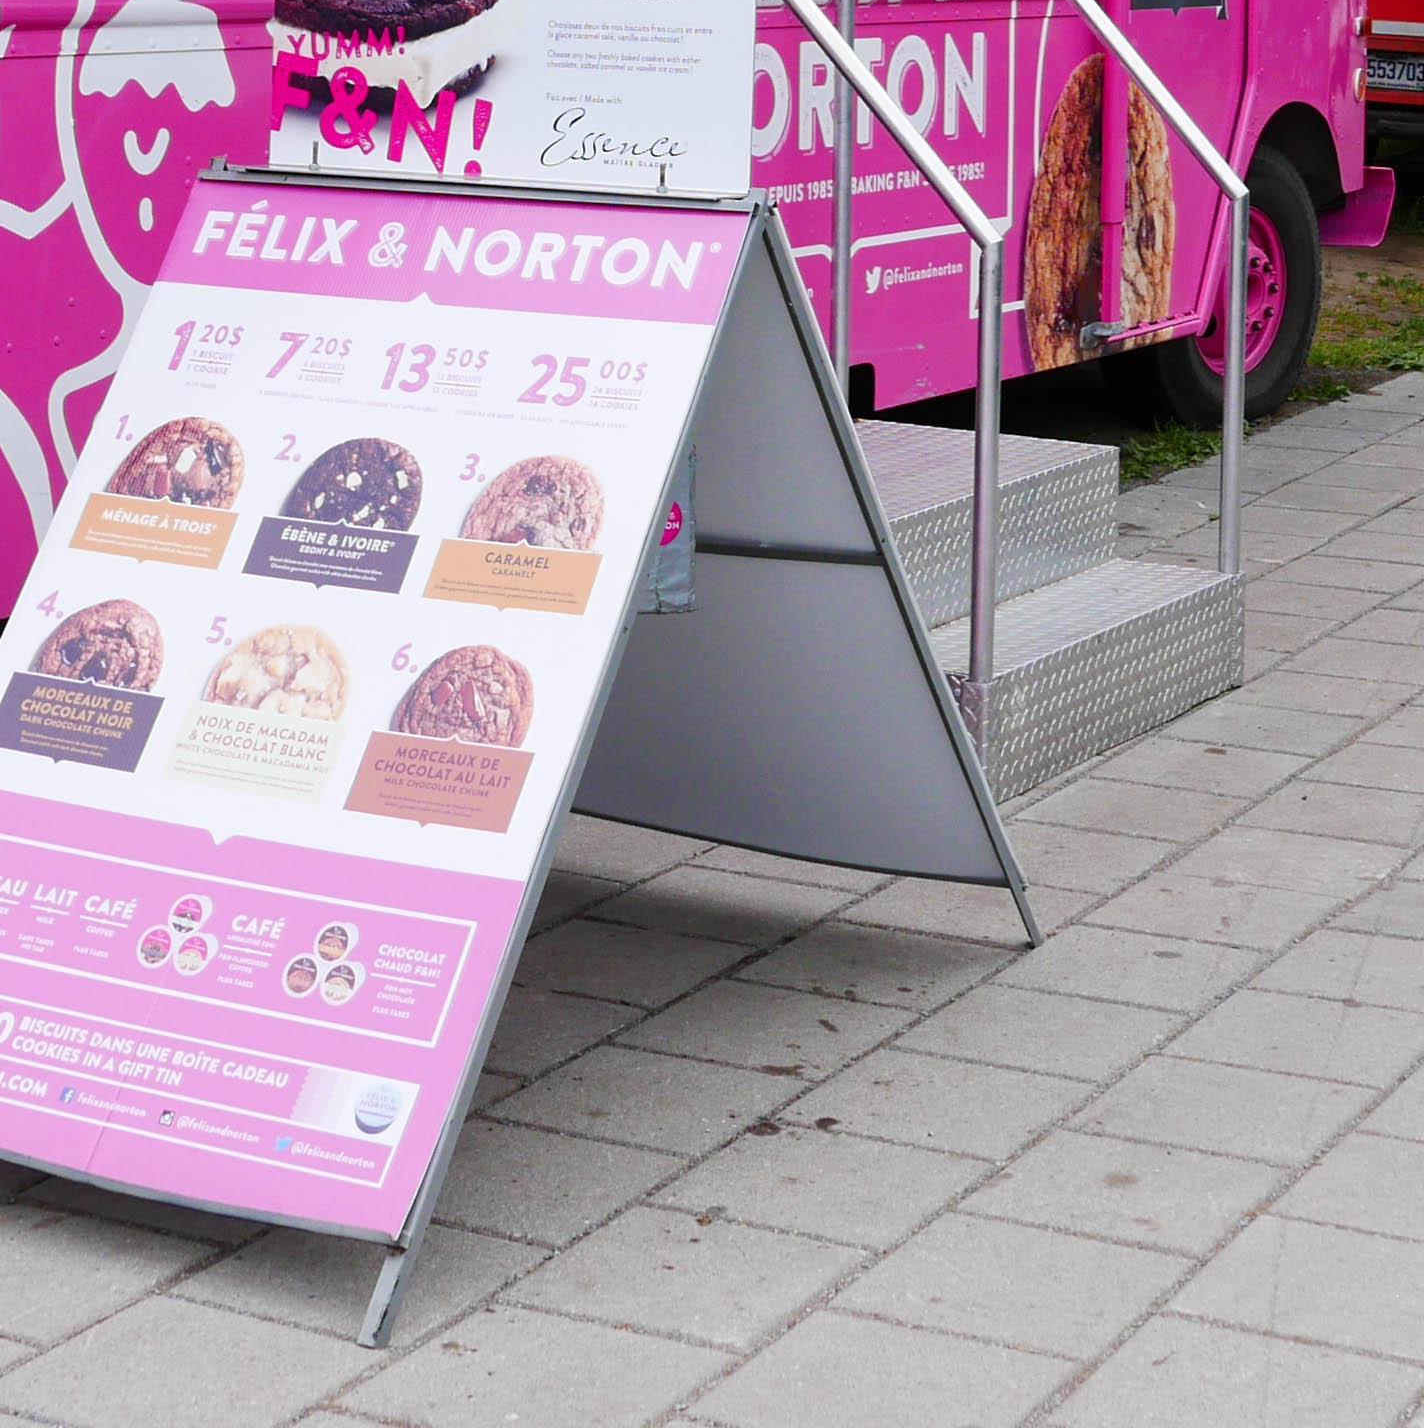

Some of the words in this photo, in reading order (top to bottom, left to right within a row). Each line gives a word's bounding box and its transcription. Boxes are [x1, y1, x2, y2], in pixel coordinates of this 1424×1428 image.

[287, 26, 407, 62] YUMM!
[751, 32, 986, 162] ORTON
[540, 107, 688, 167] Essence
[638, 161, 673, 169] GLACR
[958, 162, 985, 181] 1985!
[768, 182, 804, 205] EPUIS
[851, 173, 894, 195] BAKING
[897, 170, 920, 189] F&N
[192, 199, 360, 268] FÉLIX
[367, 221, 409, 269] &
[883, 262, 964, 290] @felixandnorton
[114, 414, 133, 441] 1.
[275, 434, 302, 462] 2.
[459, 452, 486, 483] 3.
[101, 507, 159, 528] MÉNAGE
[160, 514, 171, 530] À
[281, 524, 326, 546] ÉBÈNE
[328, 532, 339, 547] &
[484, 551, 550, 570] CARAMEL
[37, 590, 64, 619] 4.
[205, 616, 233, 646] 5.
[391, 642, 418, 673] 6.
[20, 698, 95, 723] CHOCOLAT
[96, 712, 134, 730] NOIR
[33, 686, 110, 710] MORCEAUX
[113, 700, 133, 714] DE
[44, 718, 92, 733] CHOCOLATE
[197, 715, 233, 732] NOIX
[236, 721, 255, 735] DE
[257, 726, 329, 748] MACADAM
[189, 730, 198, 741] &
[203, 731, 278, 754] CHOCOLAT
[280, 744, 326, 762] BLANC
[394, 746, 475, 768] MORCEAUX
[480, 757, 501, 772] DE
[375, 759, 452, 781] CHOCOLAT
[454, 771, 475, 784] AU
[479, 774, 512, 789] LAIT
[384, 777, 404, 786] MILK
[406, 779, 457, 795] CHOCOLATE
[33, 884, 79, 908] LAIT
[84, 895, 138, 921] CAFÉ
[231, 914, 286, 940] CAFÉ
[373, 958, 412, 975] CHAUD
[378, 943, 446, 967] CHOCOLAT
[12, 1035, 80, 1064] COOKIES
[83, 1051, 102, 1069] IN
[102, 1056, 117, 1072] A
[118, 1058, 152, 1081] GIFT
[156, 1065, 184, 1087] TIN
[19, 1015, 89, 1045] BISCUITS
[90, 1031, 136, 1055] DANS
[136, 1042, 171, 1064] UNE
[171, 1049, 220, 1074] BOÎTE
[222, 1062, 289, 1089] CADEAU
